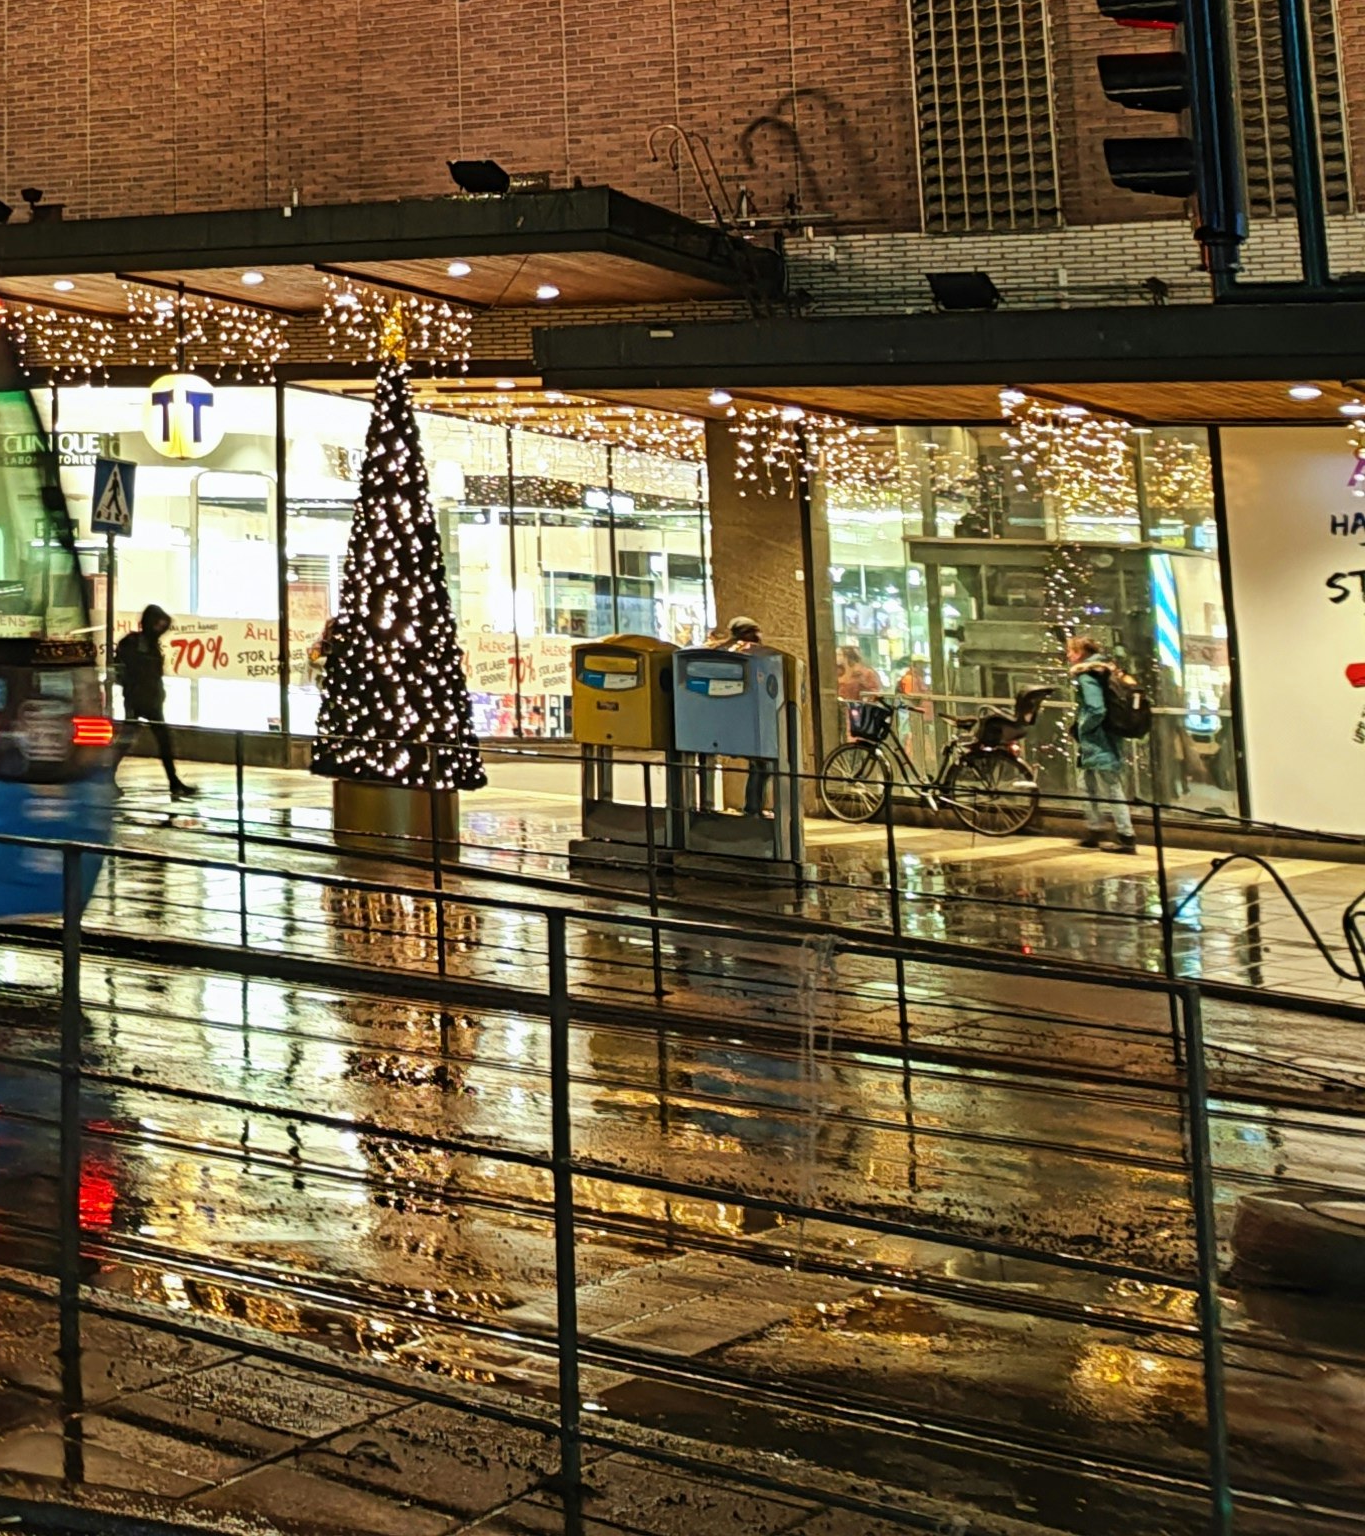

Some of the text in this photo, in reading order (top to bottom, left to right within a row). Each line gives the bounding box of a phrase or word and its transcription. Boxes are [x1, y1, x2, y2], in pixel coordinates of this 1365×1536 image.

[185, 389, 214, 443] T
[170, 634, 229, 675] 70%
[237, 649, 267, 664] STOR
